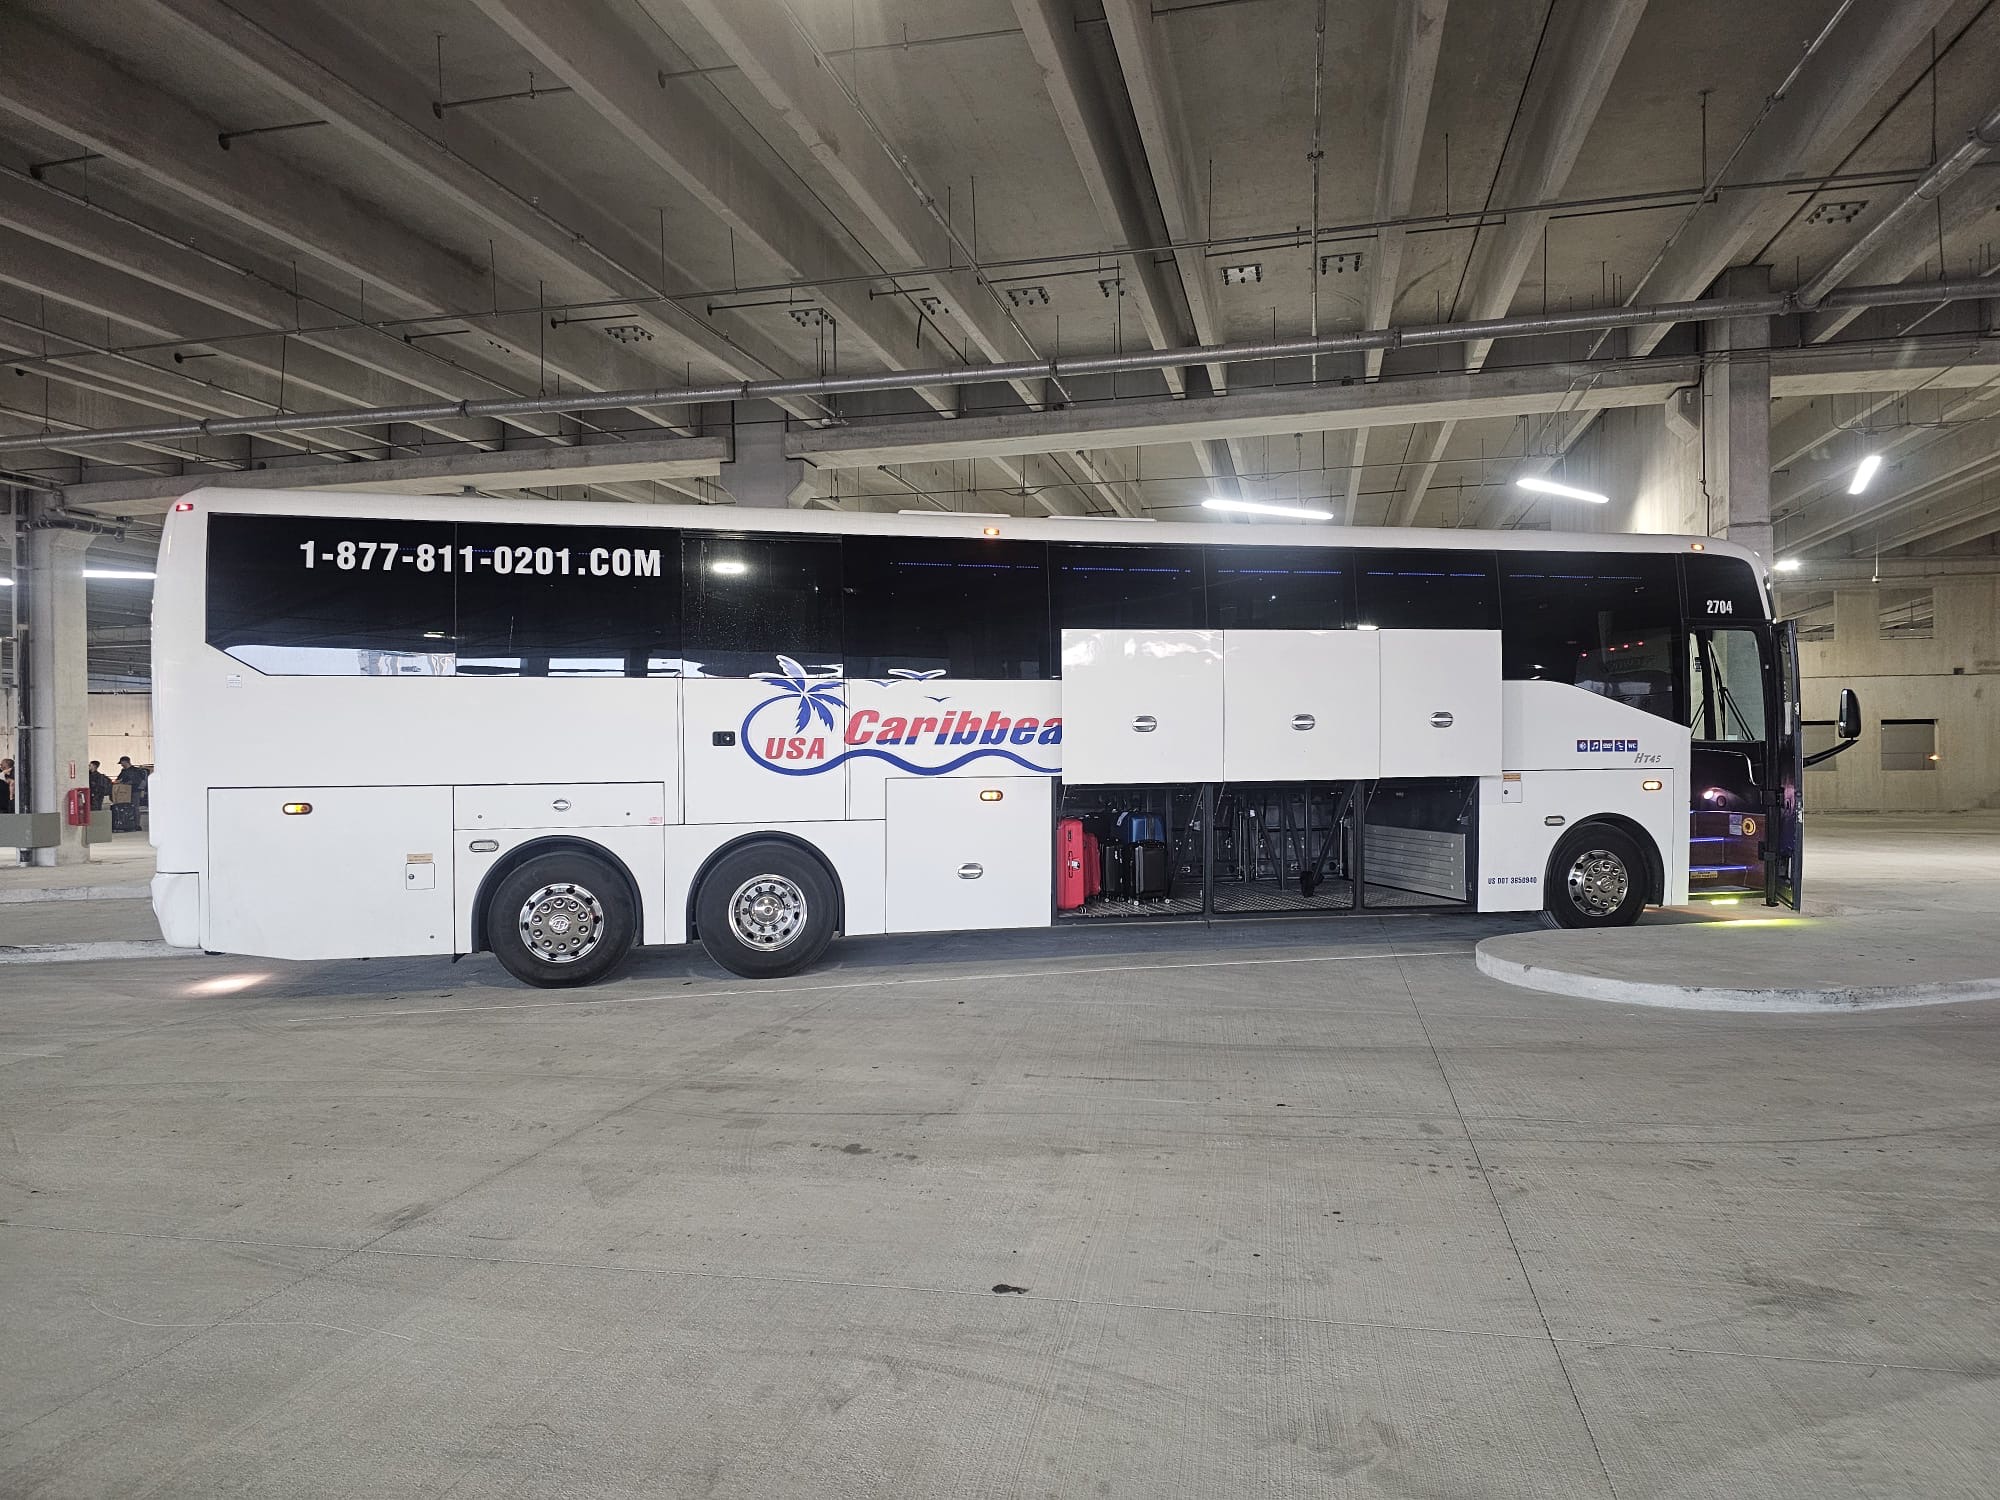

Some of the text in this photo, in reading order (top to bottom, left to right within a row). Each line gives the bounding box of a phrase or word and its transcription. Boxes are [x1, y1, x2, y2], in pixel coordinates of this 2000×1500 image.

[299, 540, 662, 577] 1-877-811-0201.COM
[1706, 599, 1733, 614] 2704
[764, 737, 825, 760] USA
[1633, 752, 1662, 764] HT45
[1497, 877, 1509, 885] DOT
